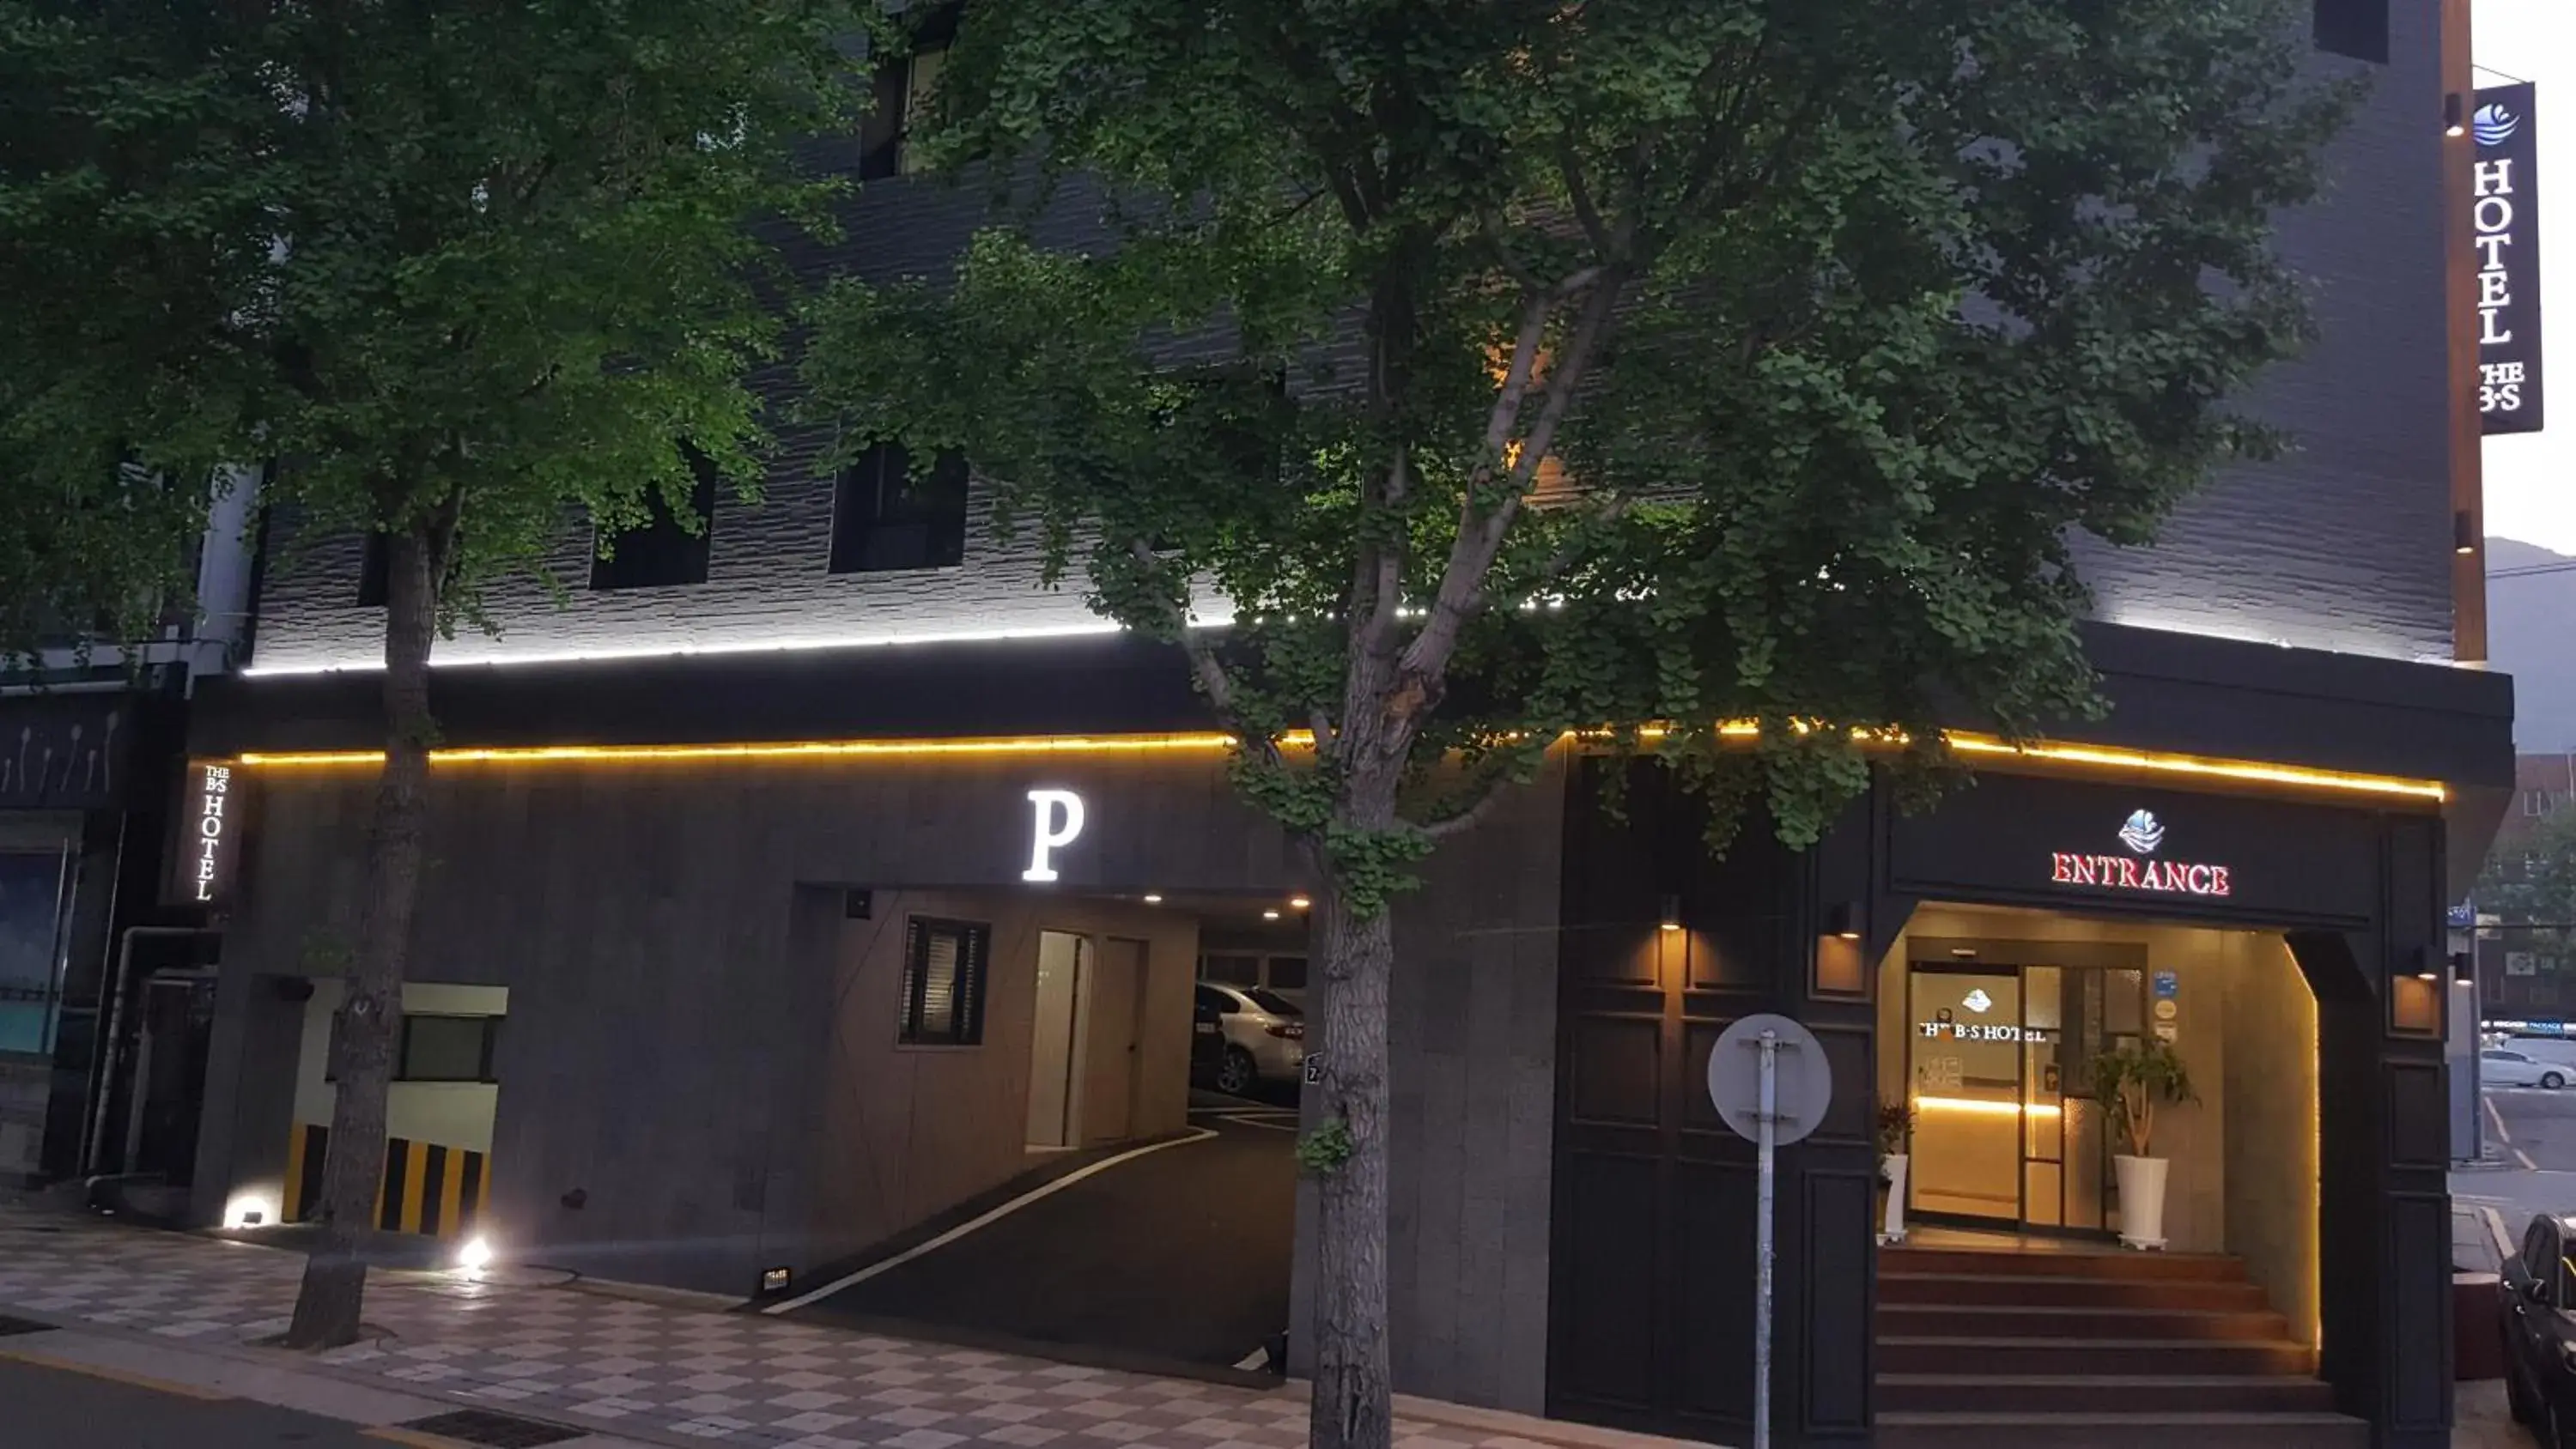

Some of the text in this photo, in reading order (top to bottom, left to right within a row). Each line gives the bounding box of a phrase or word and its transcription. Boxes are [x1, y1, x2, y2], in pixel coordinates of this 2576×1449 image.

[2474, 158, 2513, 345] HOTEL
[205, 765, 230, 779] THE
[196, 794, 224, 901] HOTEL
[1022, 789, 1085, 882] P
[2051, 852, 2231, 895] ENTRANCE
